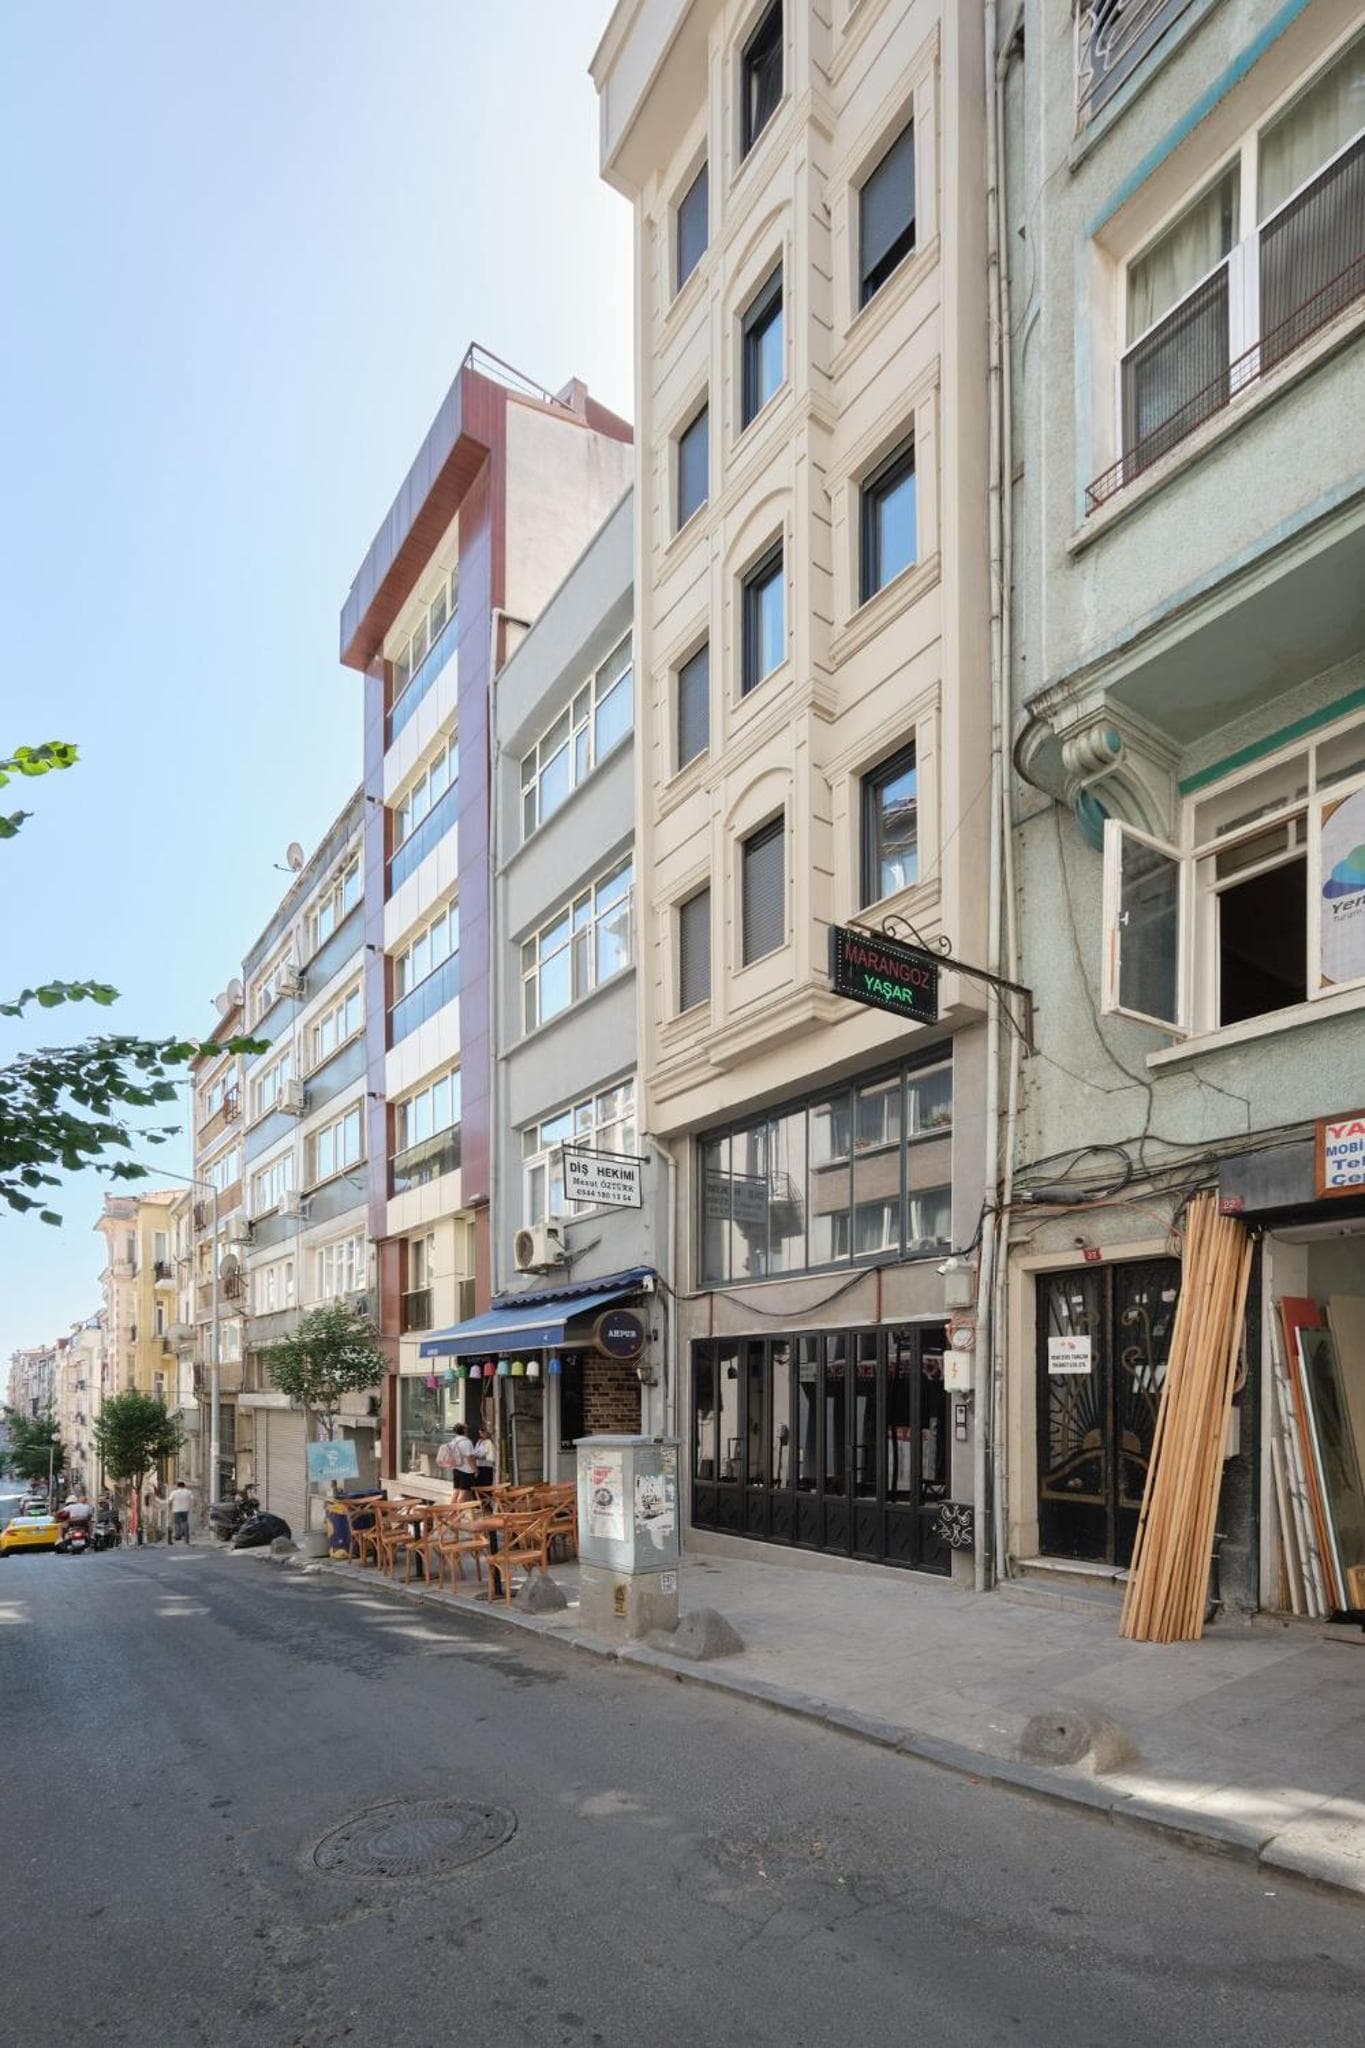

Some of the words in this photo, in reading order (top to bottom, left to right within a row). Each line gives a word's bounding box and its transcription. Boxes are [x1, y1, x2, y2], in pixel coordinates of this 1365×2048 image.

[844, 943, 930, 989] MARANGOZ
[864, 974, 913, 1004] YAŞAR
[570, 1162, 589, 1176] DİŞ
